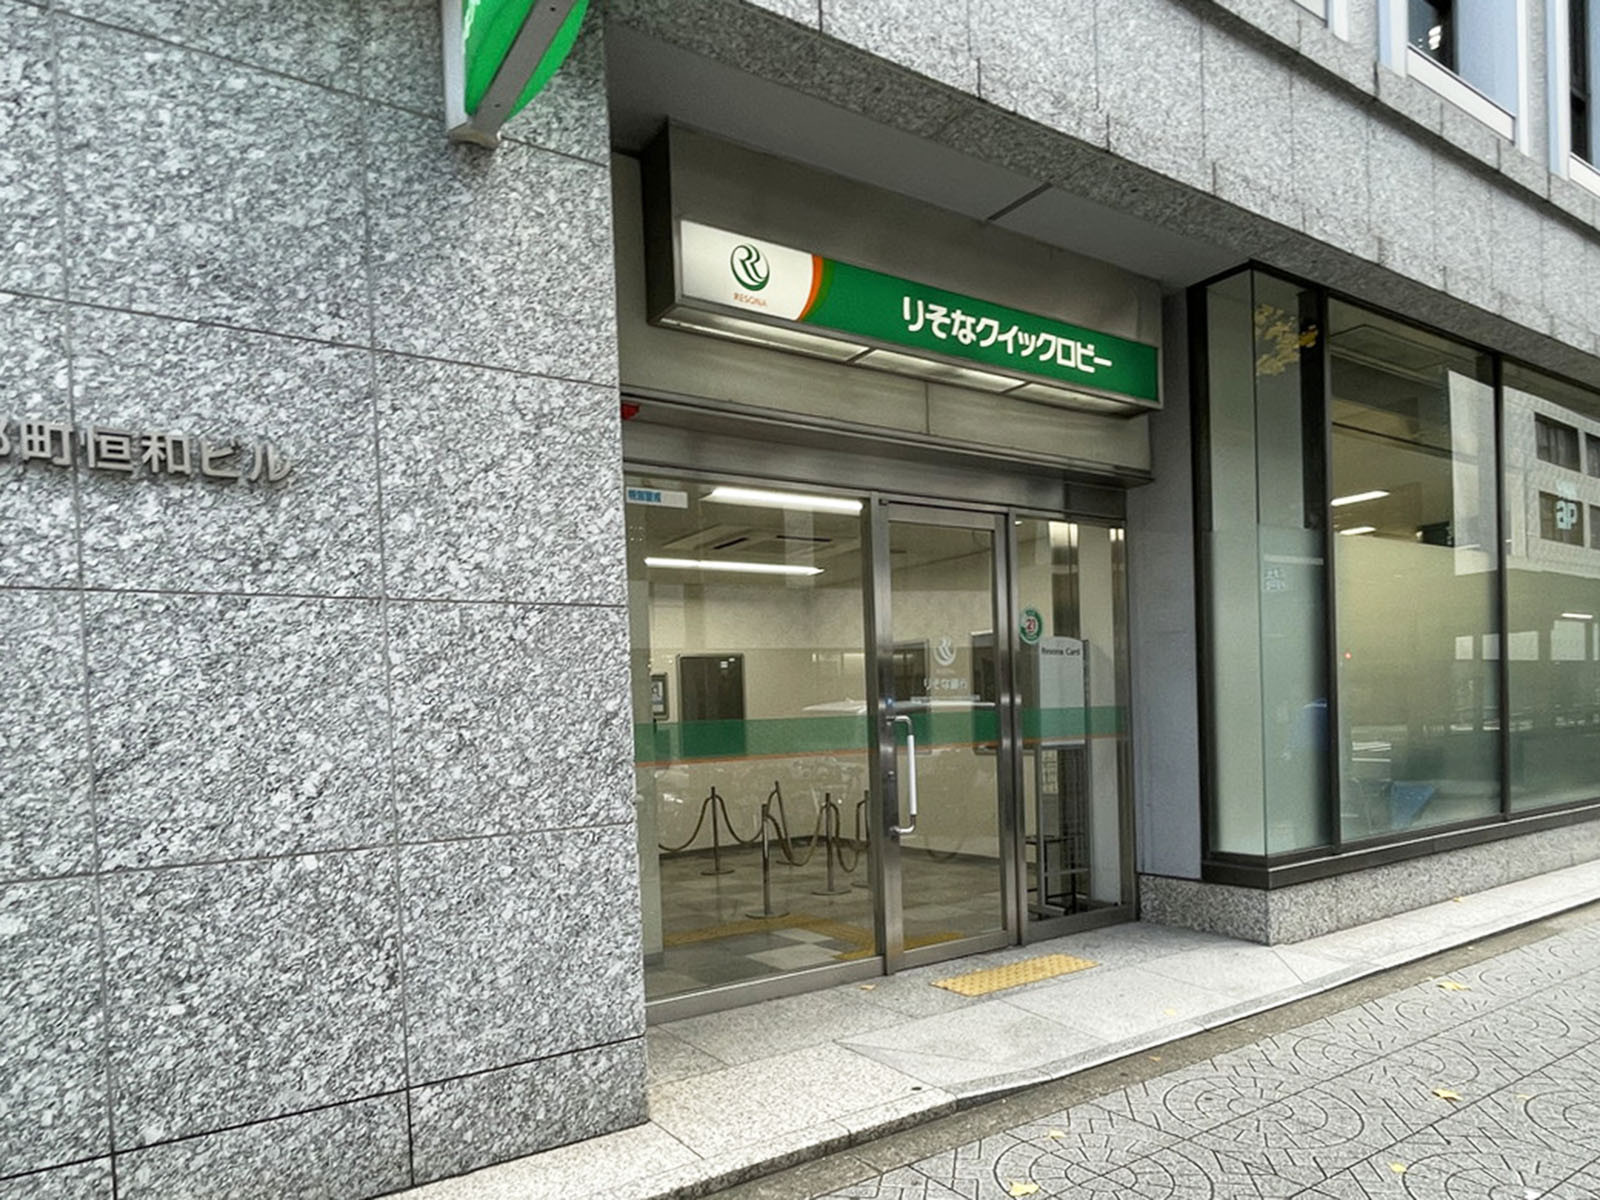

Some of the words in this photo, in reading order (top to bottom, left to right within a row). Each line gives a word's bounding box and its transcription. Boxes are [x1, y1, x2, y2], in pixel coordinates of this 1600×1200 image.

[902, 296, 1113, 374] りそなクイックロビー
